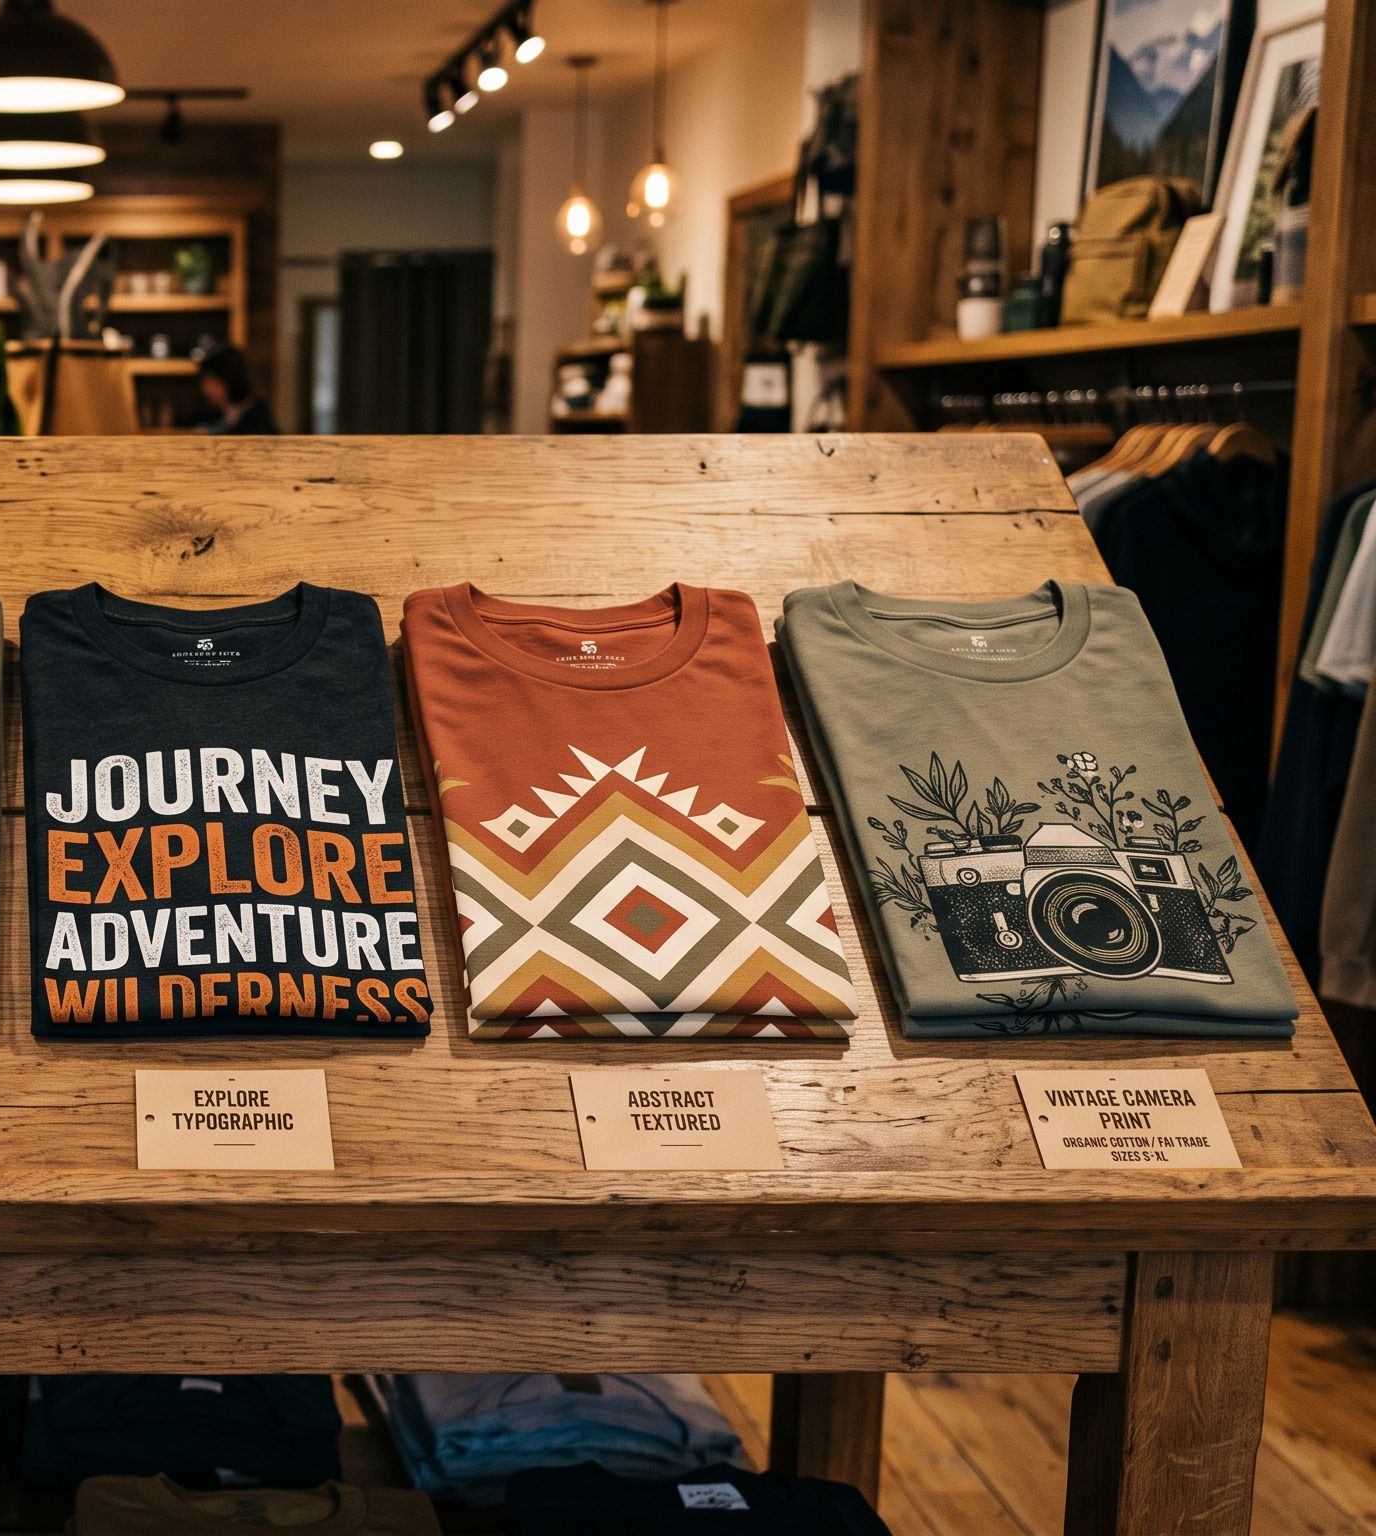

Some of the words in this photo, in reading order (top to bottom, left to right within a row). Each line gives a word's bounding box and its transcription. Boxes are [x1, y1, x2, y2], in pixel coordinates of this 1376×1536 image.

[46, 748, 393, 824] JOURNEY
[48, 823, 414, 904] EXPLORE
[45, 903, 424, 970] ADVENTURE
[194, 1091, 270, 1107] EXPLORE
[629, 1091, 714, 1107] ABSTRACT
[1045, 1090, 1120, 1106] VINTAGE
[1123, 1090, 1196, 1106] CAMERA
[172, 1113, 293, 1130] TYPOGRAPHIC
[631, 1114, 720, 1130] TEXTURED
[1099, 1112, 1151, 1129] PRINT
[1063, 1137, 1108, 1147] ORGANIC
[1110, 1137, 1150, 1147] COTTON
[1158, 1137, 1174, 1147] FAI
[1111, 1151, 1141, 1161] SIZES
